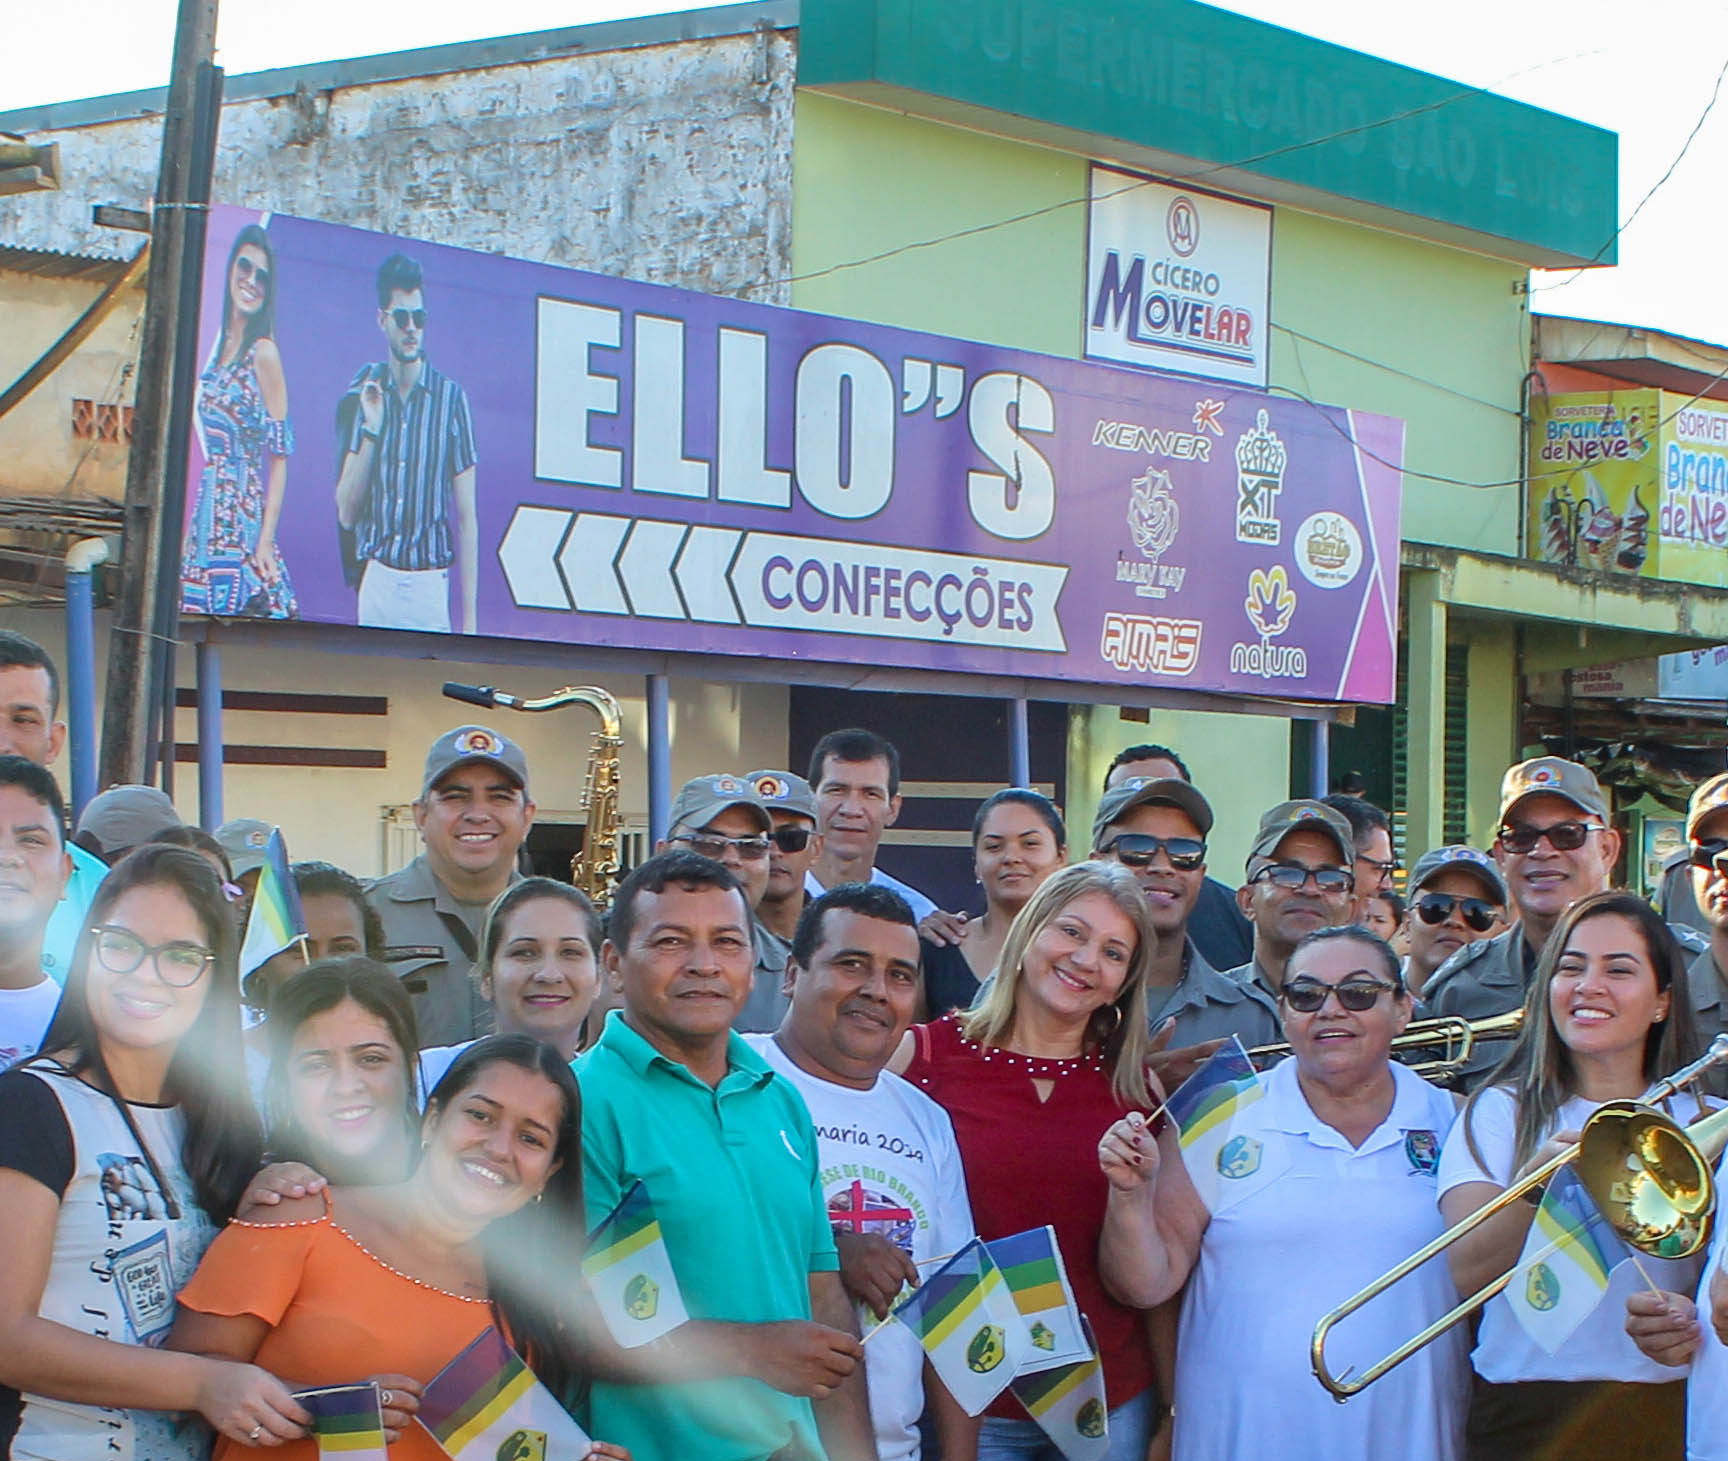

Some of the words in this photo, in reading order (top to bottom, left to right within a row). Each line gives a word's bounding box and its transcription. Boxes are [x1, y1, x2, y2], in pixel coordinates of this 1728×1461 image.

[1151, 257, 1221, 297] CÍCERO
[1093, 419, 1212, 463] KENNER
[1542, 442, 1564, 461] de
[1566, 439, 1630, 461] Neve
[1547, 420, 1624, 440] Branca
[1660, 502, 1690, 538] de
[761, 554, 1034, 636] CONFECÇÕES
[1231, 637, 1308, 679] natura
[888, 1177, 930, 1230] BRANCO
